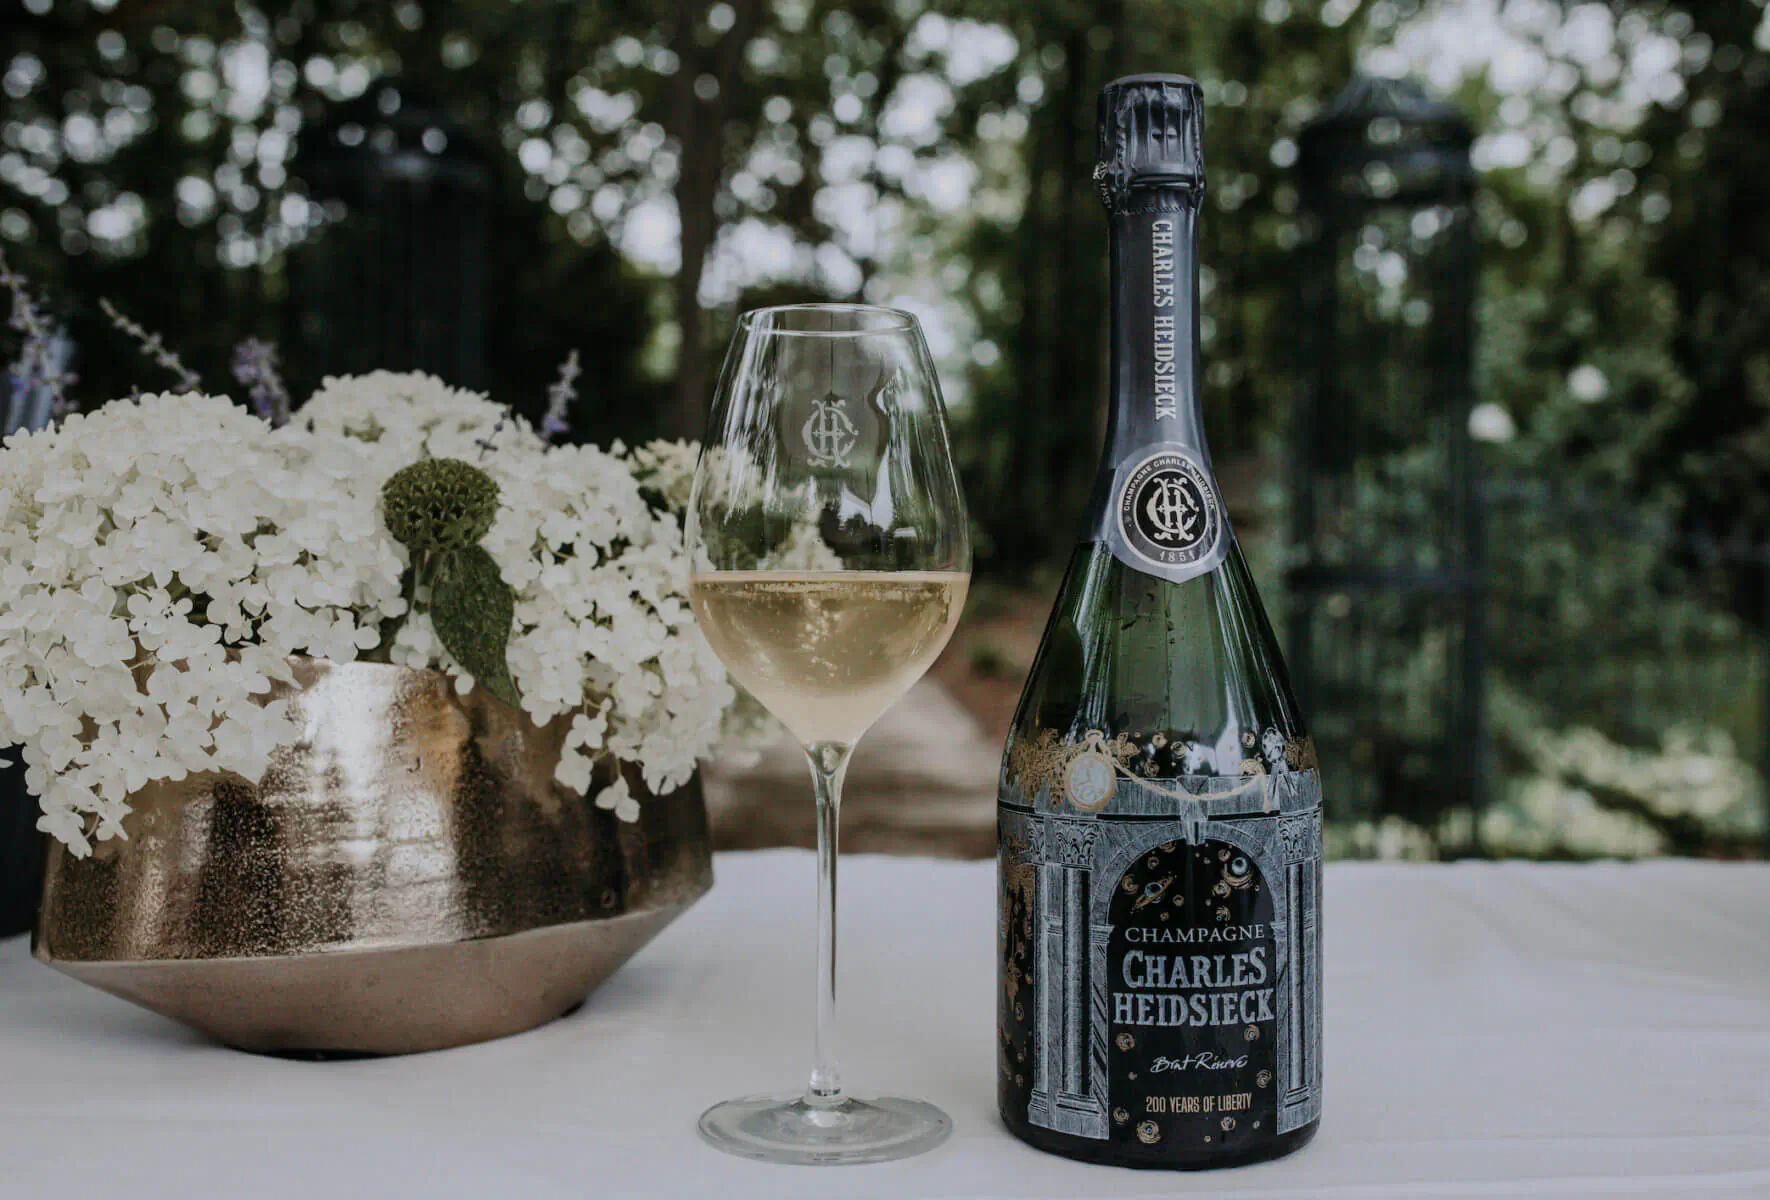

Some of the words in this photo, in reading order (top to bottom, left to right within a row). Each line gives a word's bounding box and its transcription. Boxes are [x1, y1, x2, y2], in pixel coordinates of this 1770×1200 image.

[1151, 219, 1174, 308] CHARLES
[1153, 315, 1177, 421] HEIDSIECK
[1123, 464, 1153, 511] CHAMPAGNE
[1124, 923, 1265, 943] CHAMPAGNE
[1122, 946, 1267, 989] CHARLES
[1112, 987, 1275, 1027] HEIDSIECK
[1150, 1053, 1196, 1073] Brut
[1146, 1096, 1166, 1113] 200
[1169, 1096, 1200, 1113] YEARS
[1203, 1095, 1216, 1113] OF
[1217, 1092, 1252, 1112] LIBERTY
